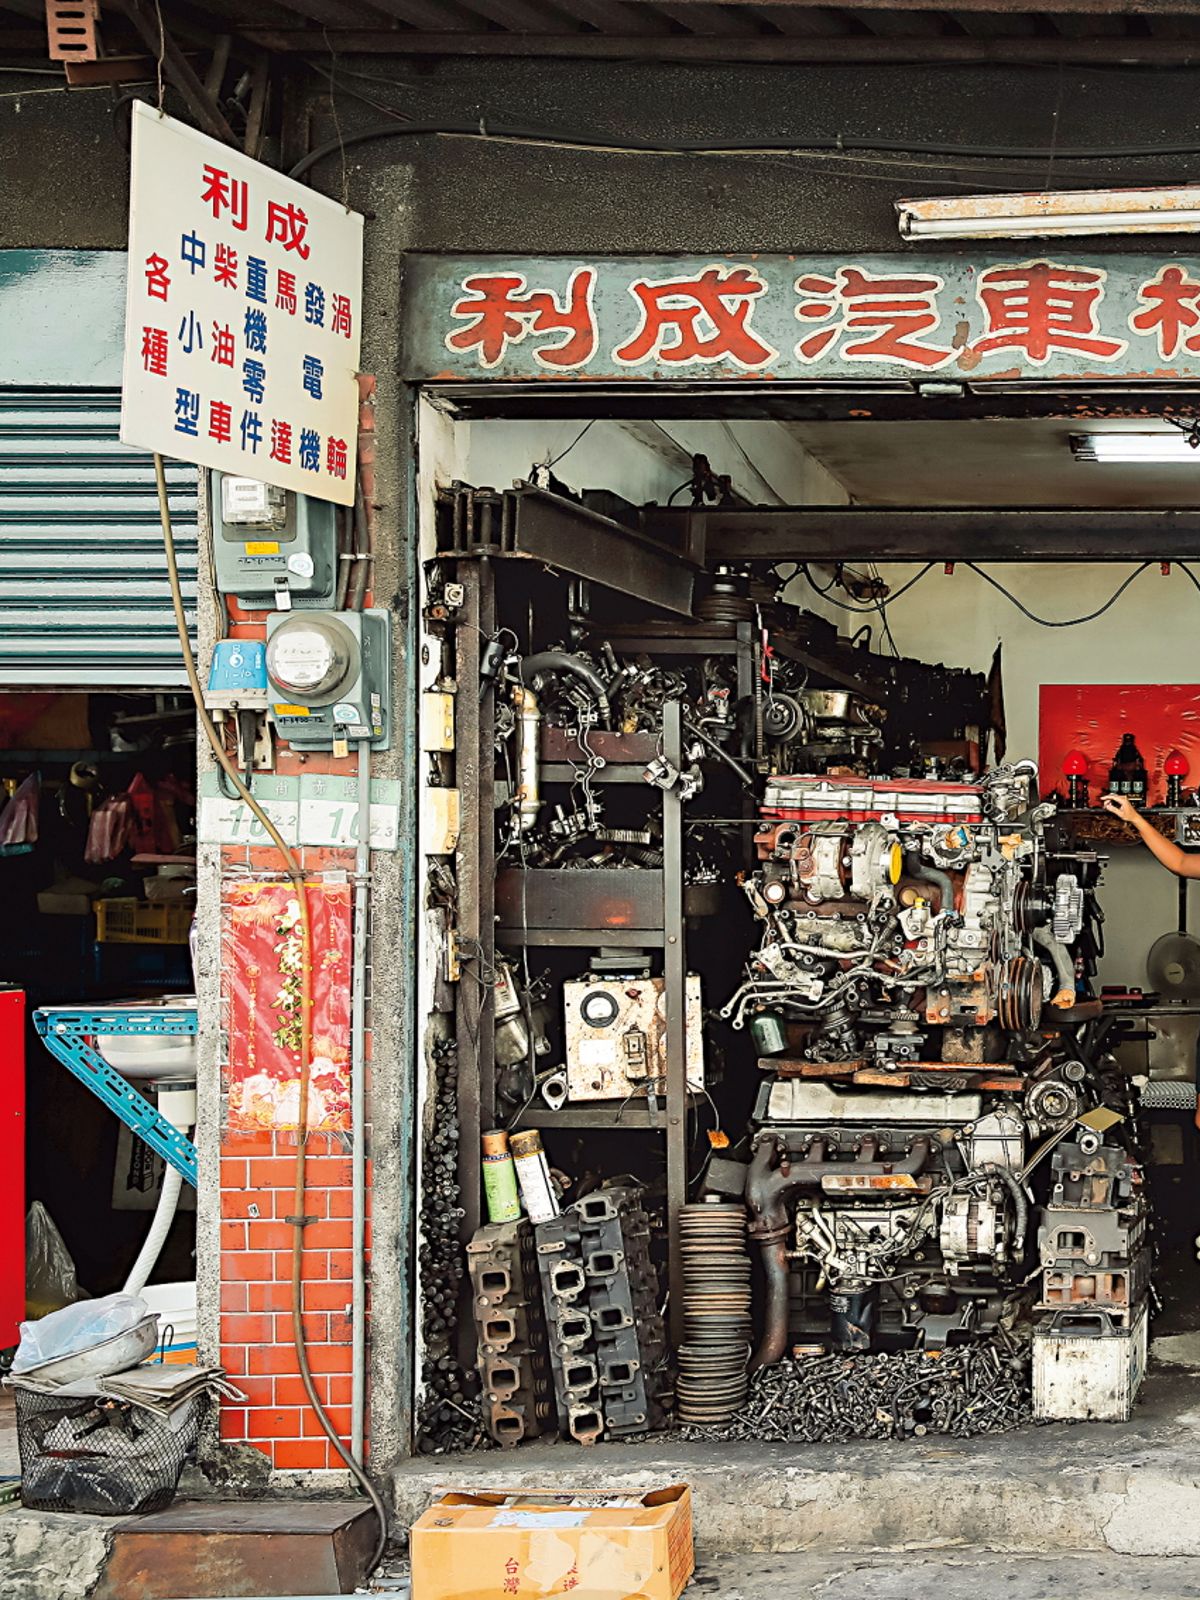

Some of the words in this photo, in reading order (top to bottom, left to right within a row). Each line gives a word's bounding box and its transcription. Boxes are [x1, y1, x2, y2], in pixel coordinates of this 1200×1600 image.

[201, 163, 311, 261] 利成
[141, 252, 172, 377] 各種
[174, 229, 206, 437] 中小型
[208, 242, 239, 444] 柴油車
[240, 255, 268, 454] 重機零件
[269, 268, 298, 465] 馬達
[299, 282, 326, 473] 發電機
[326, 293, 352, 480] 渦輪
